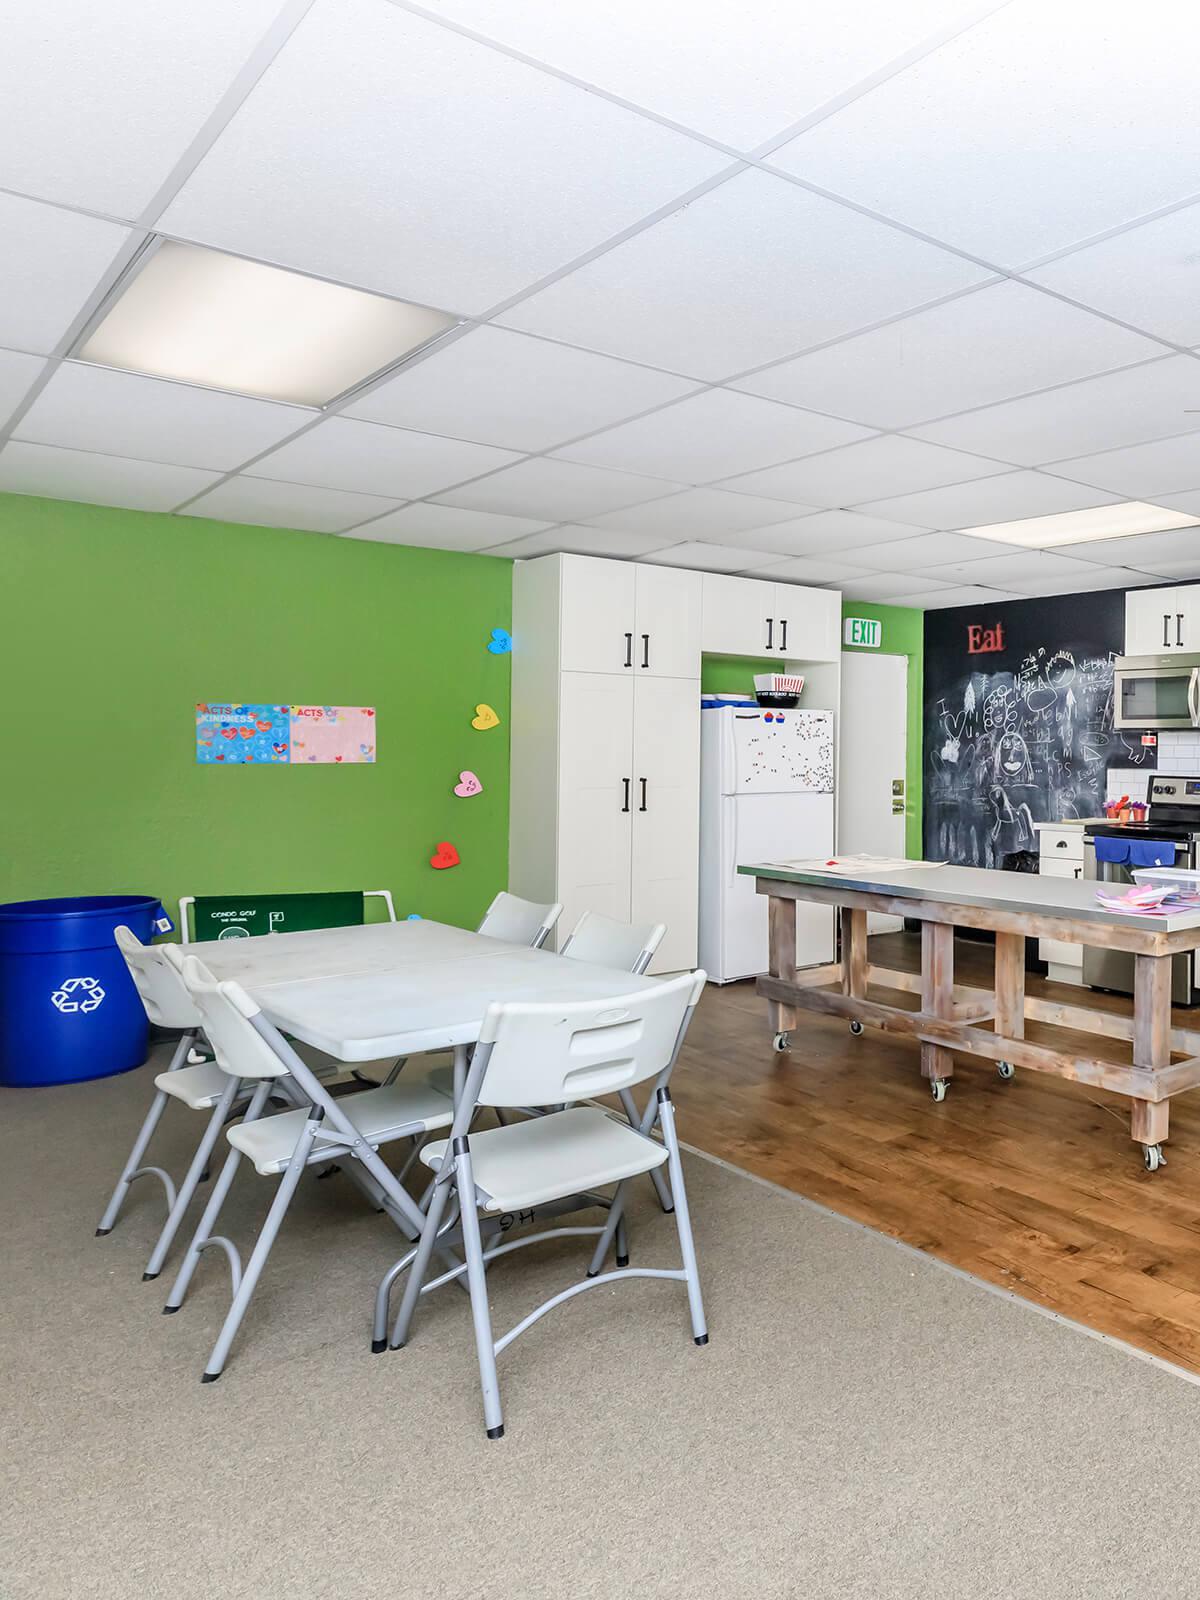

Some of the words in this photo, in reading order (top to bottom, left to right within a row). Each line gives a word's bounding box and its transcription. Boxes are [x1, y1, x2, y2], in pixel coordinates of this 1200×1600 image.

[852, 619, 878, 645] EXIT
[967, 622, 1006, 654] Eat
[297, 709, 323, 717] ACTS
